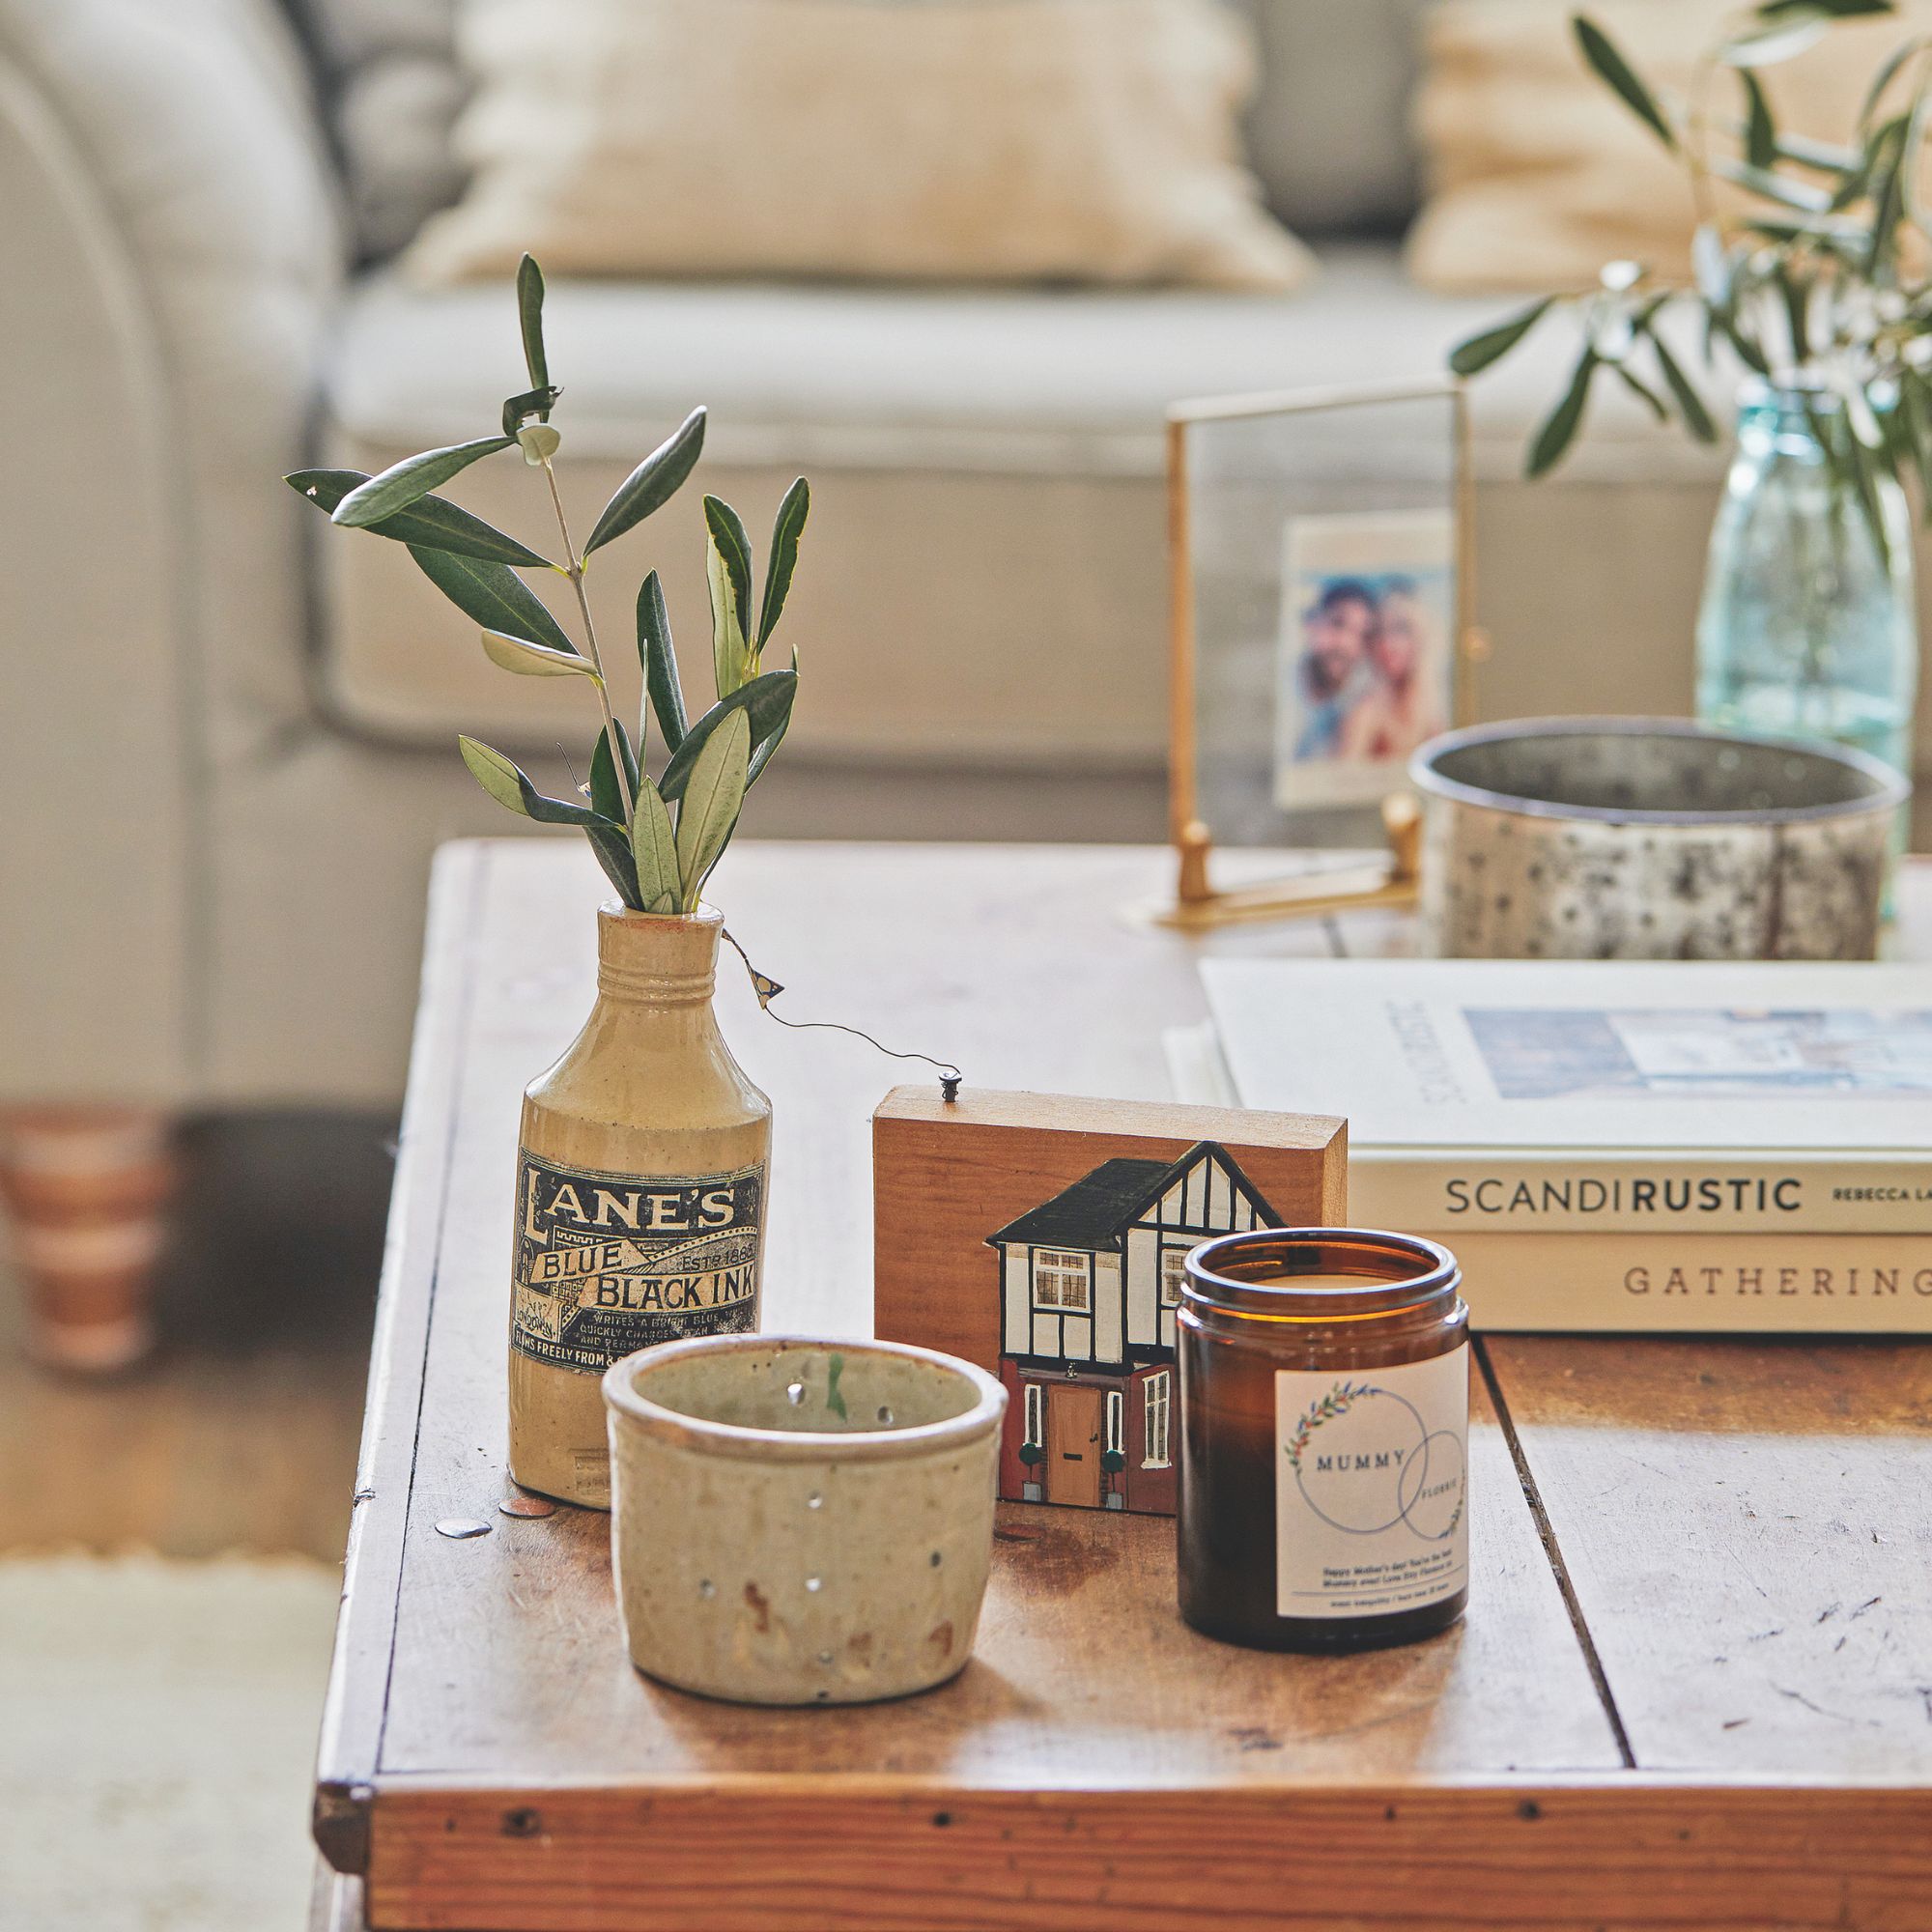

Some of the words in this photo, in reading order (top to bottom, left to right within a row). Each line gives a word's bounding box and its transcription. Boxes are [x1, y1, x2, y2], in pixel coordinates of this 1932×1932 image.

[524, 1167, 735, 1245] LANE'S
[1833, 1187, 1910, 1201] REBECCA
[543, 1243, 623, 1279] BLUE
[597, 1275, 704, 1310] BLACK
[712, 1264, 753, 1304] INK
[1624, 1266, 1932, 1296] GATHERING
[580, 1323, 622, 1337] QUICKLY
[593, 1313, 635, 1326] WRITES
[640, 1318, 648, 1327] A
[581, 1336, 602, 1346] AND
[537, 1340, 574, 1361] FREELY
[575, 1350, 605, 1367] FROM
[1317, 1450, 1406, 1471] MUMMY
